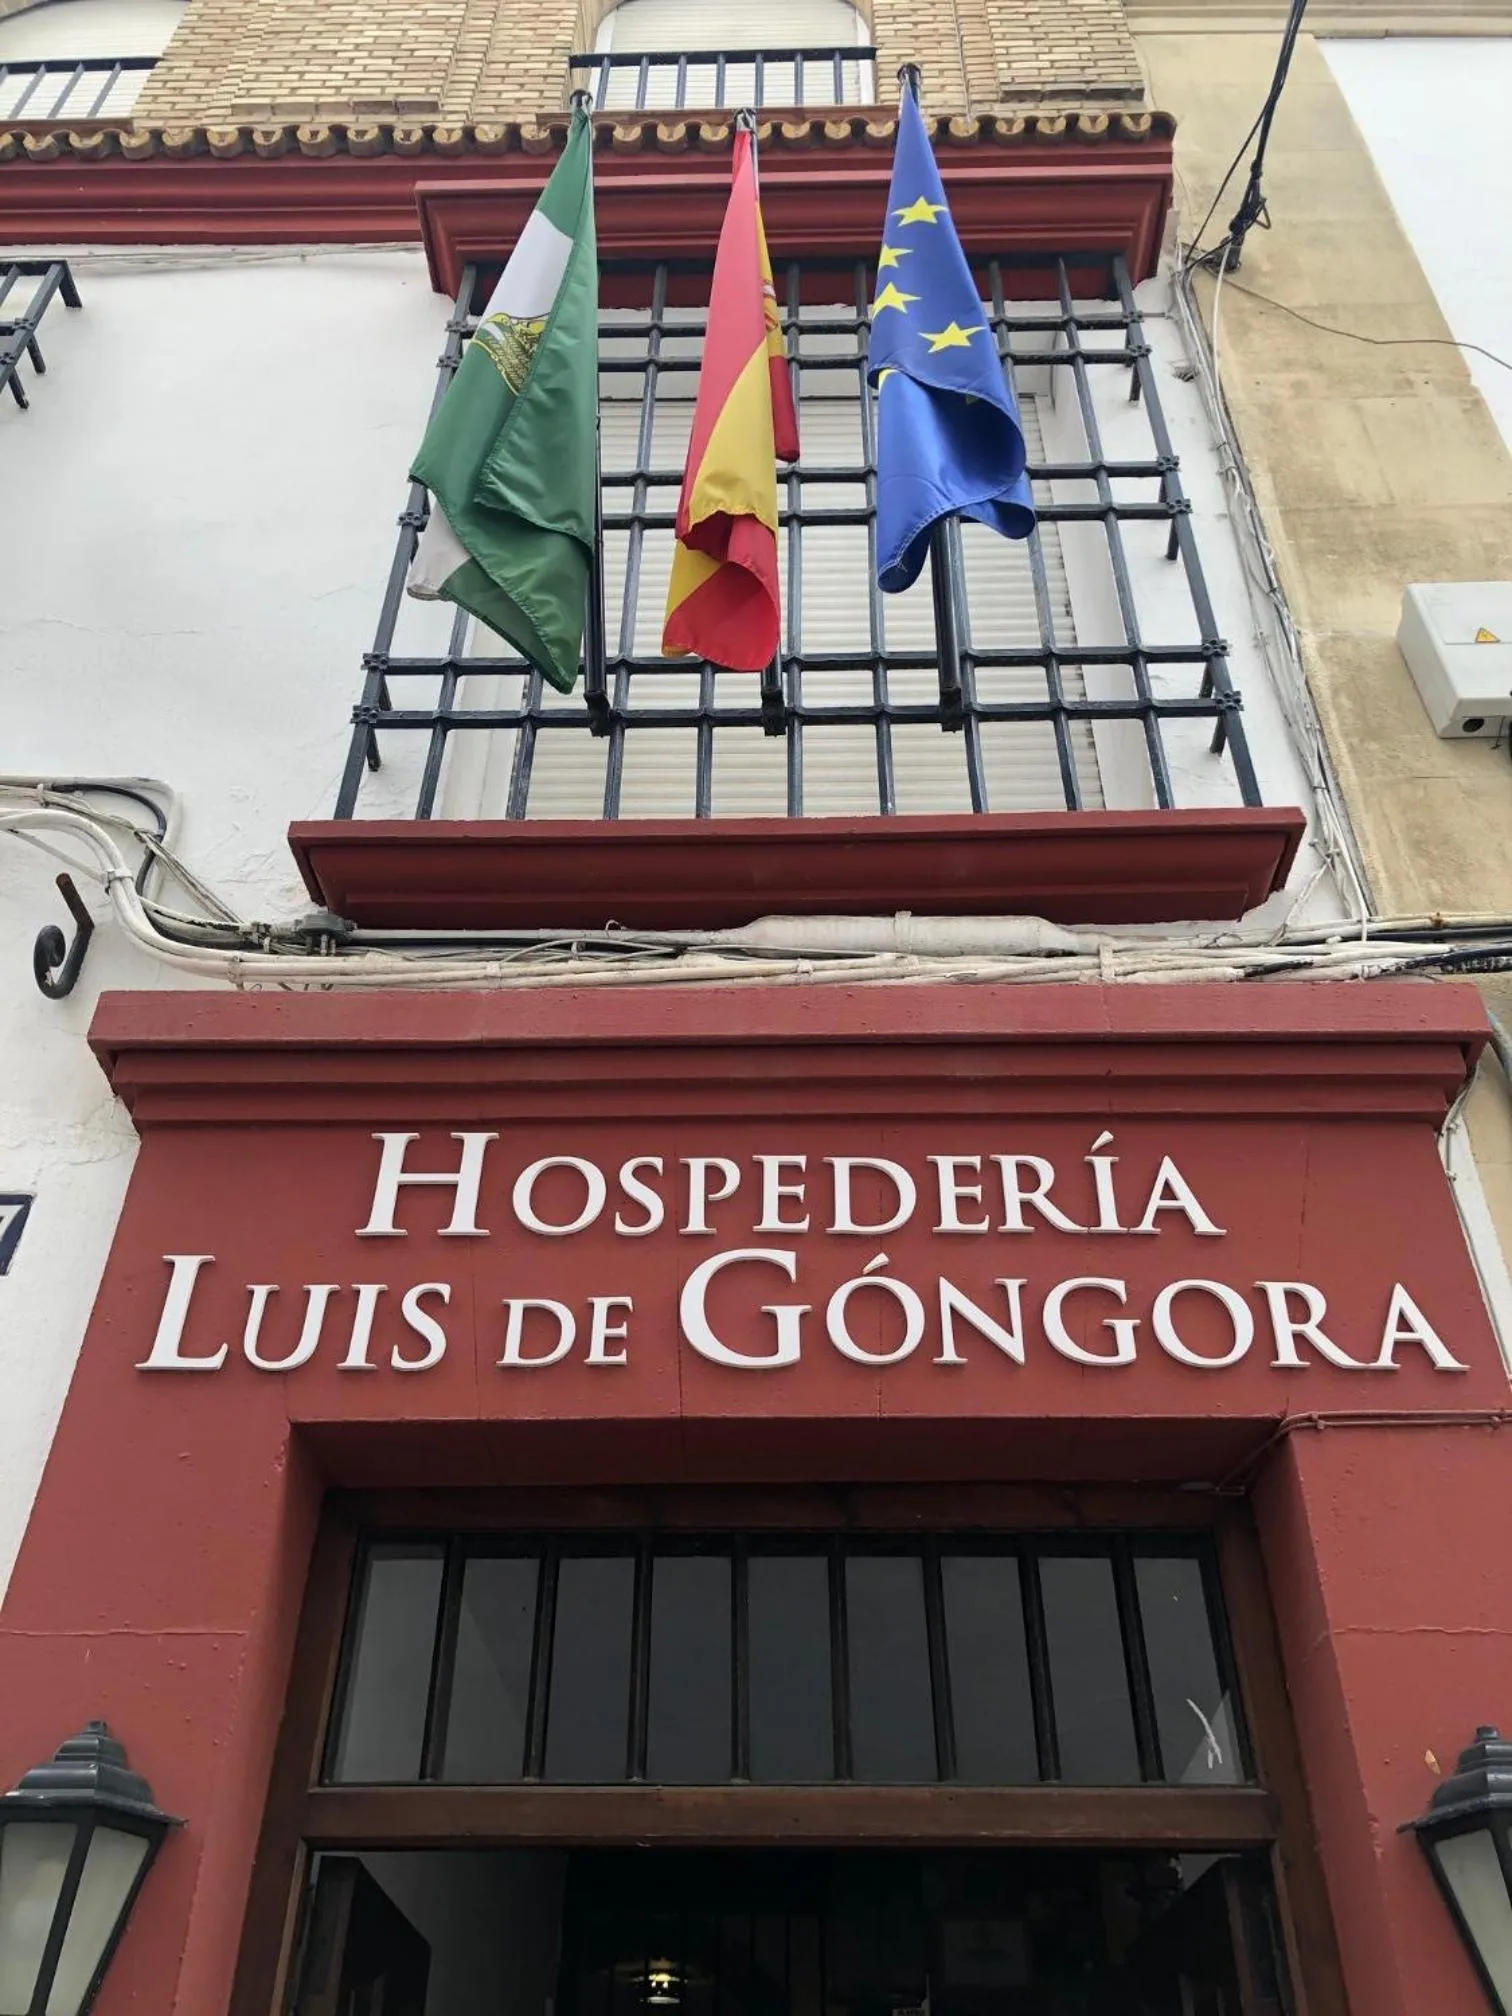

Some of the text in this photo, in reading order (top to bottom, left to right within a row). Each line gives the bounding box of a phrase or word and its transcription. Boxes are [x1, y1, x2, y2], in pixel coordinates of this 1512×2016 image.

[355, 1130, 1228, 1238] HOSPEDERÍA
[135, 1248, 1472, 1372] LUIS DE GÓNGORA
